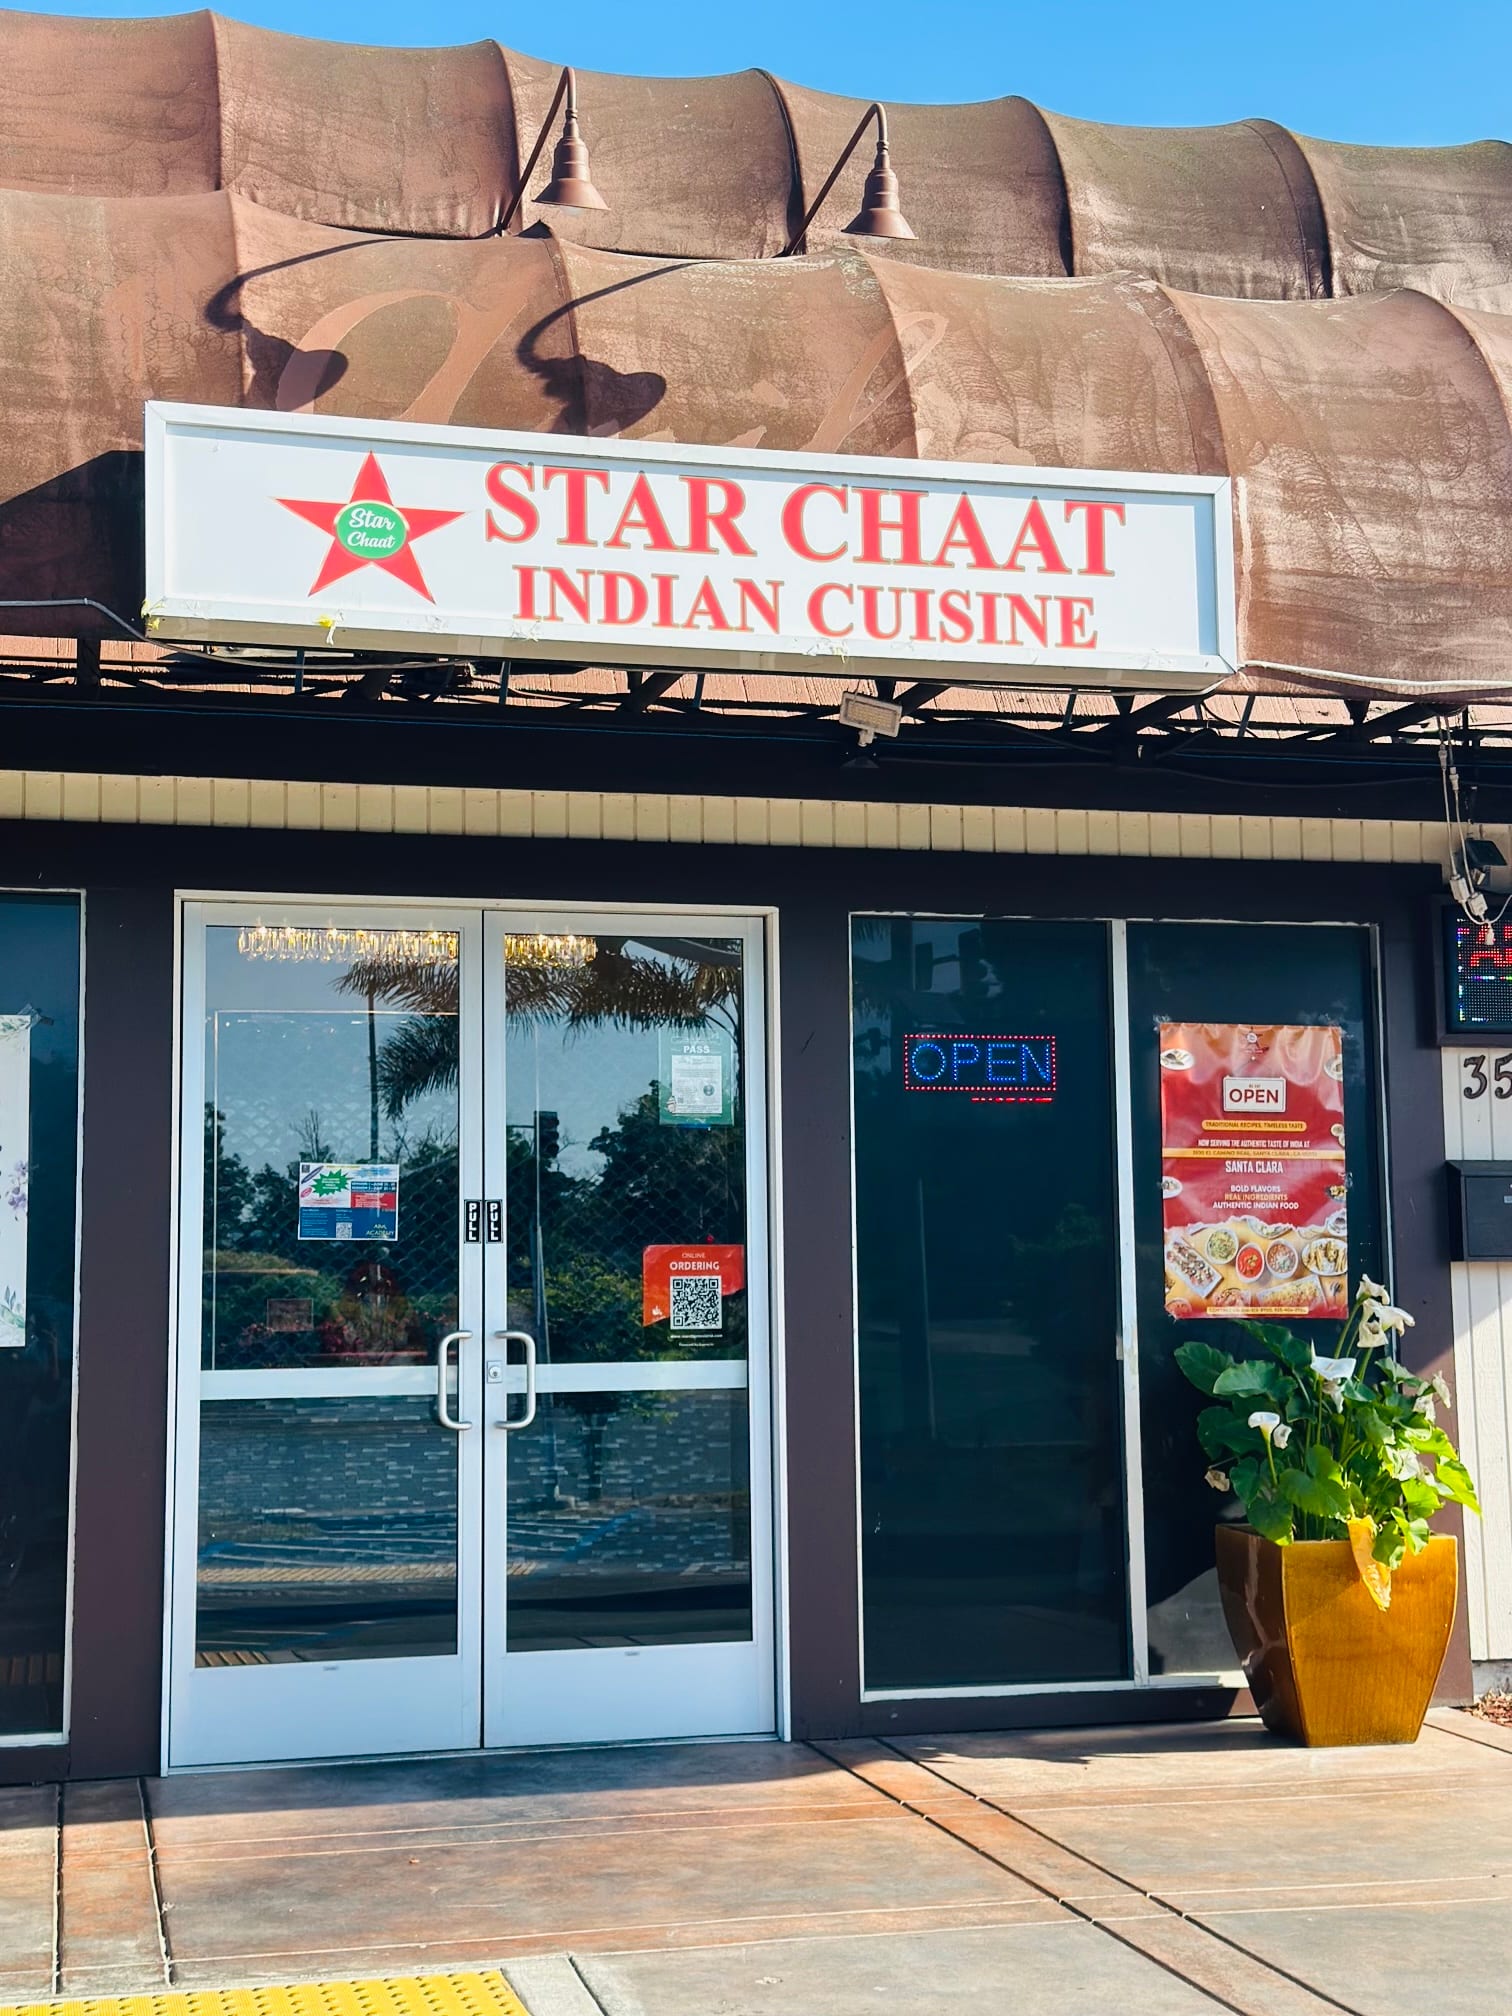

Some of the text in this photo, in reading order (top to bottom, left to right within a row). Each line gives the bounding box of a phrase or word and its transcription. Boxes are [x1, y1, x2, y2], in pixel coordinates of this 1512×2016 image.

[348, 507, 396, 532] Star
[484, 460, 1126, 577] STAR CHAAT
[346, 530, 396, 550] Chaat
[512, 564, 1098, 650] INDIAN CUISINE
[683, 1045, 711, 1054] PASS
[911, 1042, 1051, 1082] OPEN
[1228, 1088, 1279, 1104] OPEN
[1210, 1139, 1231, 1147] SERVING
[1231, 1139, 1240, 1148] THE
[1240, 1140, 1266, 1148] AUTHENTIC
[1267, 1140, 1281, 1148] TASTE
[1282, 1140, 1289, 1148] OF
[1225, 1160, 1283, 1174] SANTA CLARA
[1230, 1185, 1280, 1193] BOLD FLAVORS
[1213, 1201, 1252, 1209] AUTHENTIC
[1280, 1202, 1299, 1210] FOOD
[468, 1202, 477, 1241] PULL
[490, 1202, 499, 1241] PULL
[669, 1261, 720, 1271] ORDERING
